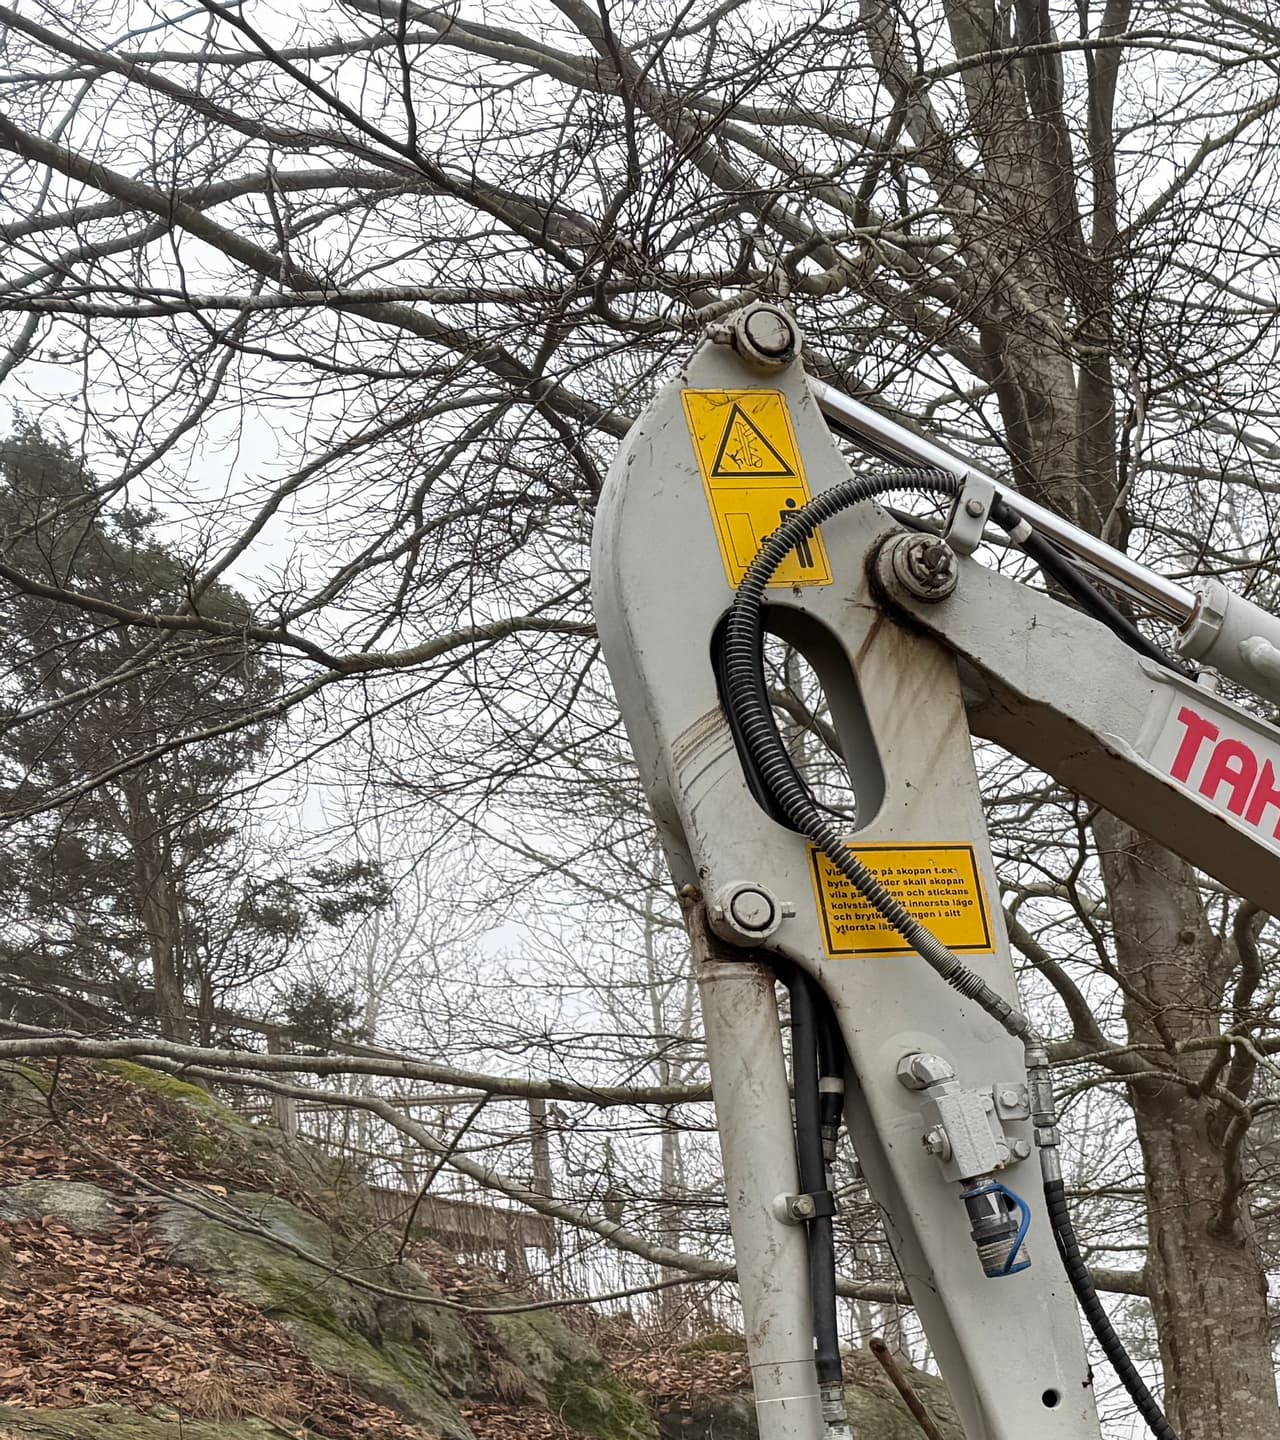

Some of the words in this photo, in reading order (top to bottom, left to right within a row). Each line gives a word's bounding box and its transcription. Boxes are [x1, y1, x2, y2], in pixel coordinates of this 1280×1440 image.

[896, 867, 932, 876] skopan
[827, 880, 850, 889] byte
[903, 878, 927, 886] skall
[929, 878, 965, 886] skopan
[829, 891, 848, 899] vila
[907, 889, 925, 897] och
[928, 888, 969, 896] stickans
[909, 899, 950, 908] innersta
[833, 913, 852, 921] och
[878, 922, 895, 932] läg
